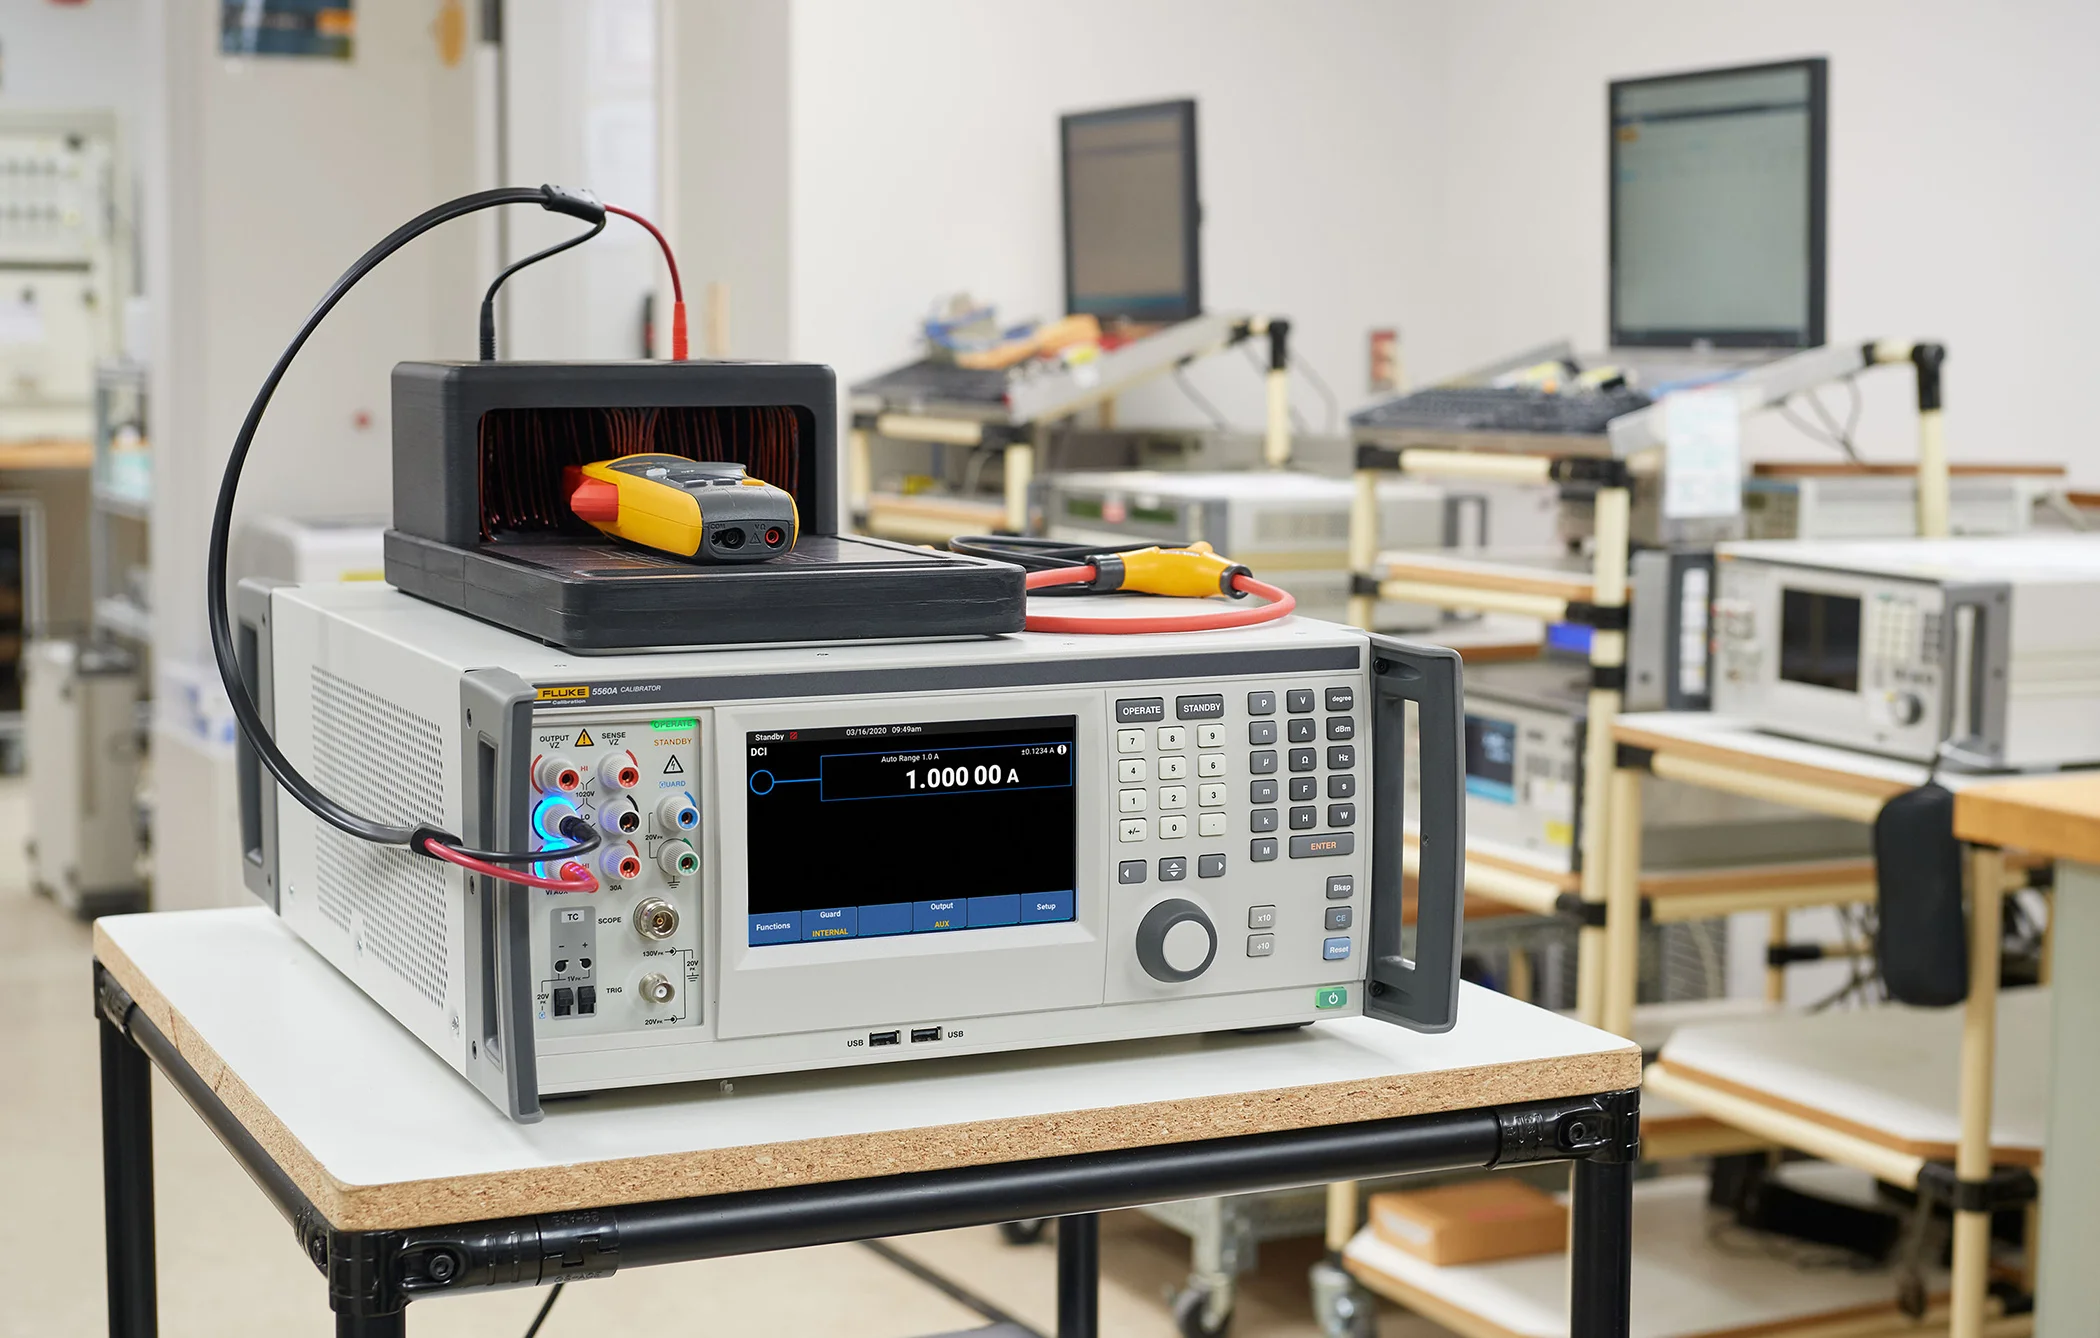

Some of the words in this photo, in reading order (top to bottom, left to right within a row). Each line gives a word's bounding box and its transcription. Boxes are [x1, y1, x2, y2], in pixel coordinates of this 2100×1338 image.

[542, 688, 586, 697] FLUKE
[592, 687, 618, 695] 5560A
[620, 685, 661, 693] CALIBRATOR
[1123, 705, 1161, 715] OPERATE
[1183, 703, 1221, 713] STANDBY
[654, 720, 693, 728] OPERATE
[846, 726, 887, 736] 03/16/2020
[892, 725, 922, 734] 09:49am
[1335, 725, 1351, 733] dBm
[755, 732, 784, 742] Standby
[1210, 732, 1215, 740] 9
[654, 738, 692, 746] STANDBY
[1130, 737, 1135, 745] 7
[751, 747, 767, 757] DCI
[1021, 747, 1048, 755] ±0.1234
[881, 755, 897, 763] Auto
[899, 754, 920, 763] Range
[1302, 756, 1308, 764] Ω
[1339, 754, 1348, 762] Hz
[1131, 767, 1136, 775] 4
[1171, 764, 1176, 772] 5
[906, 767, 969, 789] 1.000
[974, 765, 1001, 785] 00
[1007, 769, 1019, 783] A
[1132, 797, 1135, 805] 1
[1172, 794, 1176, 802] 2
[1264, 817, 1269, 825] k
[1172, 824, 1177, 832] 0
[1311, 841, 1336, 850] ENTER
[1263, 846, 1269, 854] M
[1334, 884, 1351, 892] Bksp
[930, 901, 953, 911] Output
[1037, 902, 1056, 912] Setup
[820, 910, 841, 919] Guard
[1336, 914, 1346, 922] CE
[756, 922, 791, 931] Functions
[935, 920, 950, 928] AUX
[812, 928, 848, 937] INTERNAL
[1330, 946, 1349, 954] Reset
